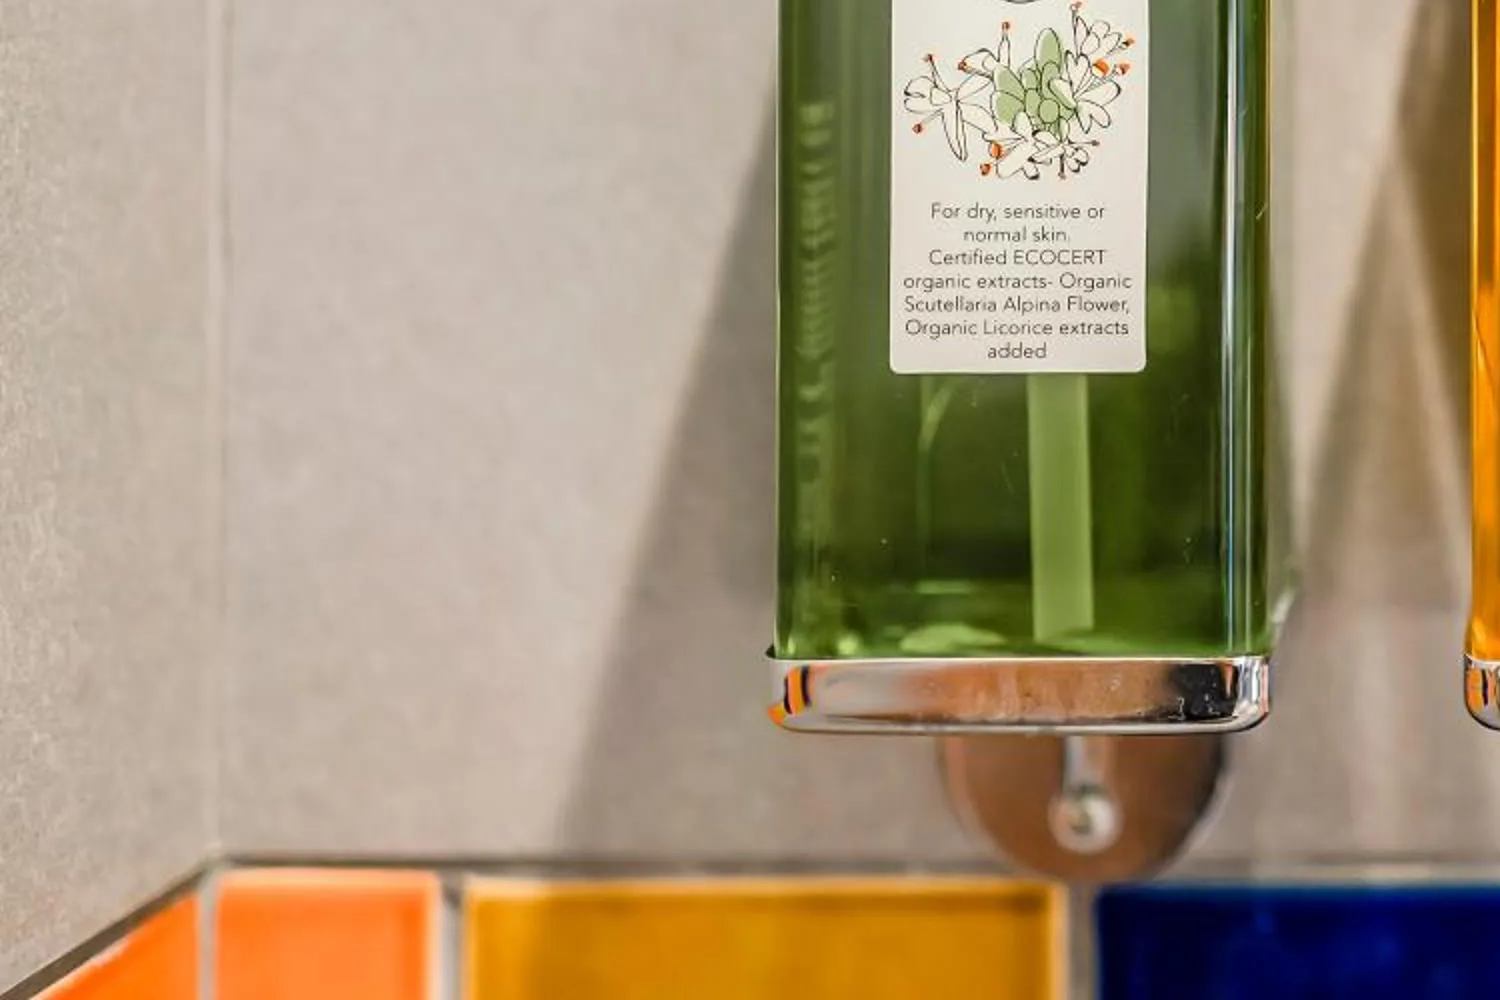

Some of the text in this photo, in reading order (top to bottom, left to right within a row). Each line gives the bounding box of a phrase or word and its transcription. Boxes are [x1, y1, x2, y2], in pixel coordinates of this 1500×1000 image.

[931, 202, 1105, 224] For dry, sensitive or
[964, 227, 1069, 242] normal skin.
[929, 249, 1106, 265] Certified ECOCERT
[903, 272, 1132, 294] organic extracts- Organic
[904, 296, 1129, 316] Scutellaria Alpina Flower,
[905, 319, 1129, 340] Organic Licorice extracts
[988, 343, 1046, 359] added
